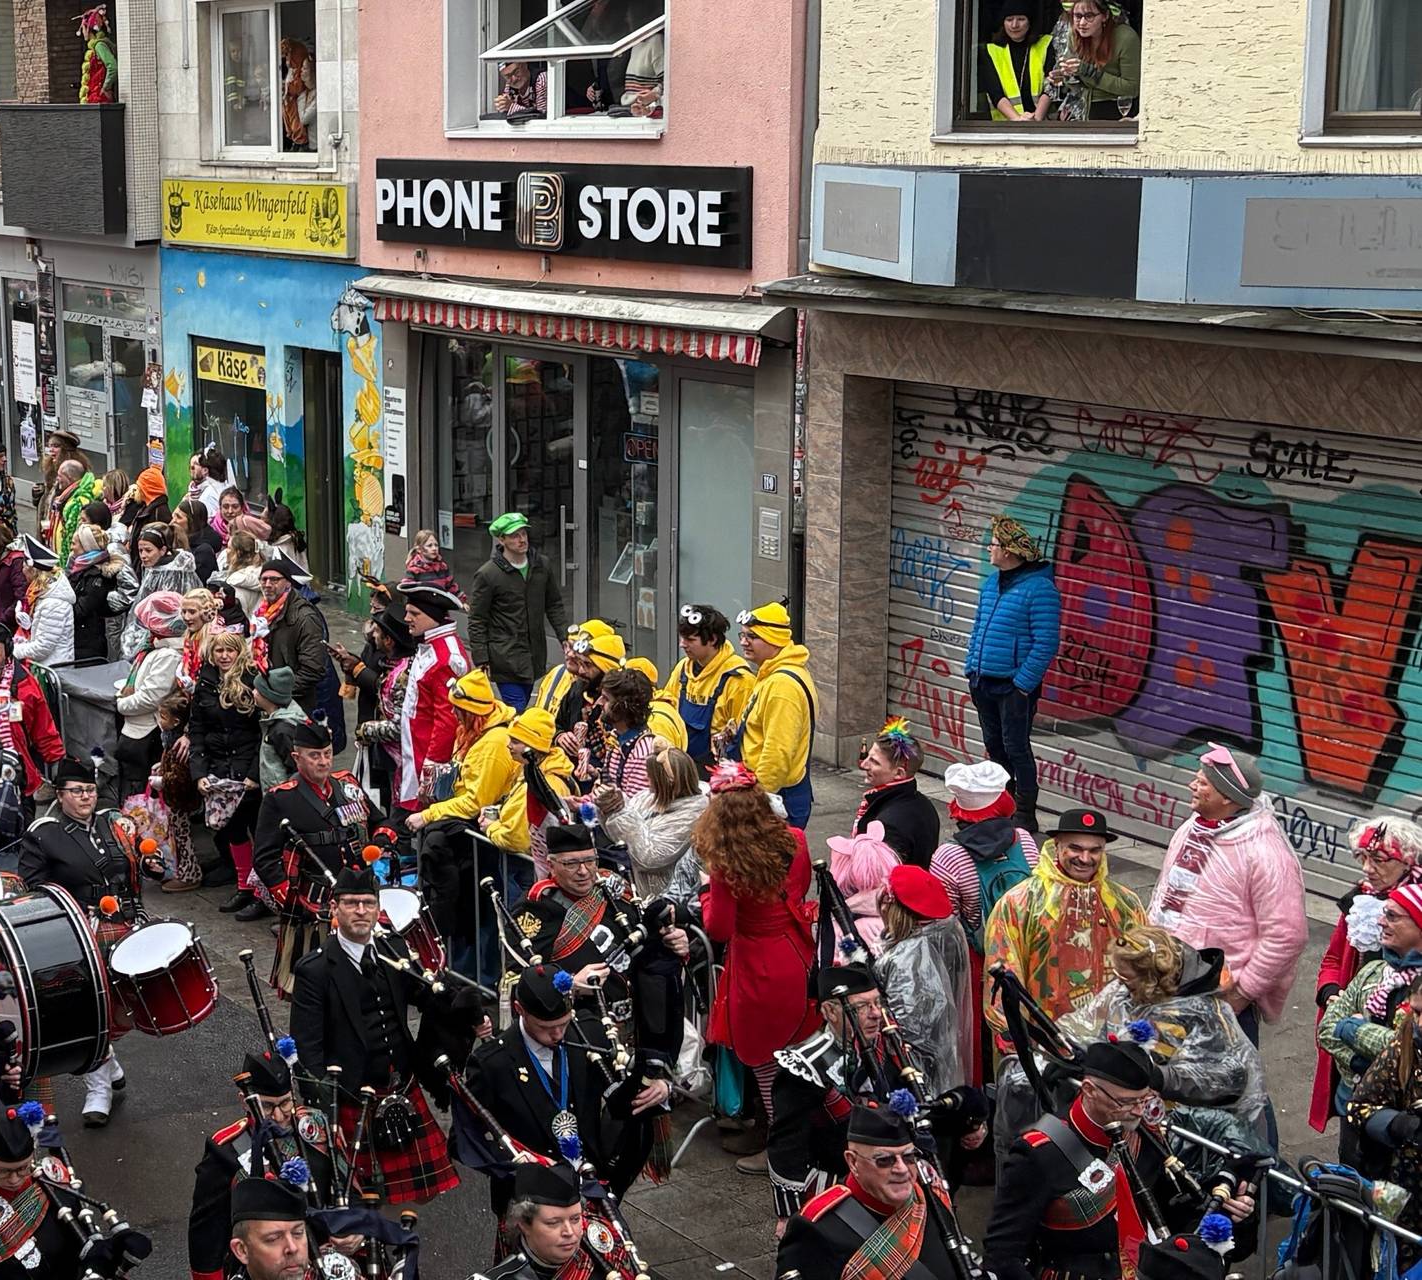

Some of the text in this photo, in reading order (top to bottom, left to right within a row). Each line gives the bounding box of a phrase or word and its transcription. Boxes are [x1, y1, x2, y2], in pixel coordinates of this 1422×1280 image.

[193, 187, 310, 223] Käsehaus Wingenfeld
[376, 177, 502, 232] PHONE
[578, 184, 722, 248] STORE
[217, 350, 248, 380] Käse
